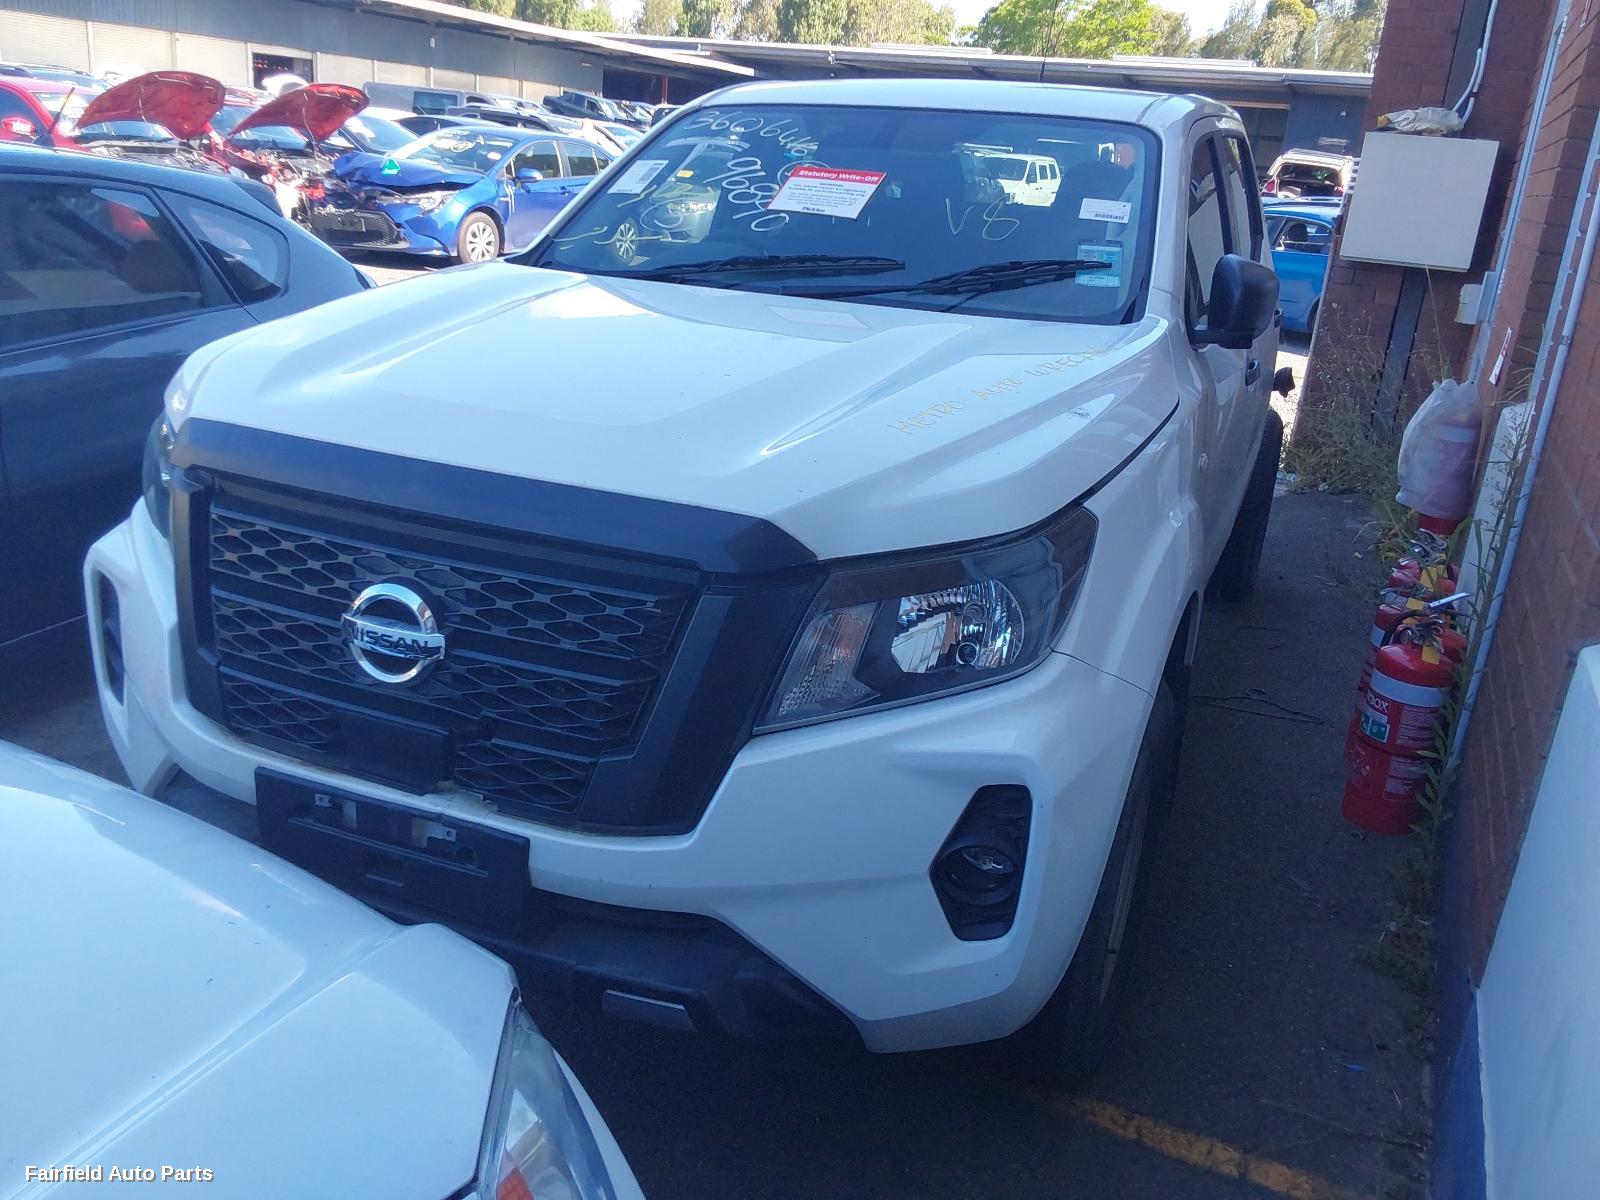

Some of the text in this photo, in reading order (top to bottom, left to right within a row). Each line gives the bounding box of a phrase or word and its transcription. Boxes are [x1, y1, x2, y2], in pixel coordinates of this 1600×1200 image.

[799, 169, 879, 183] Statutory Write-Off
[353, 627, 429, 654] NISSAN
